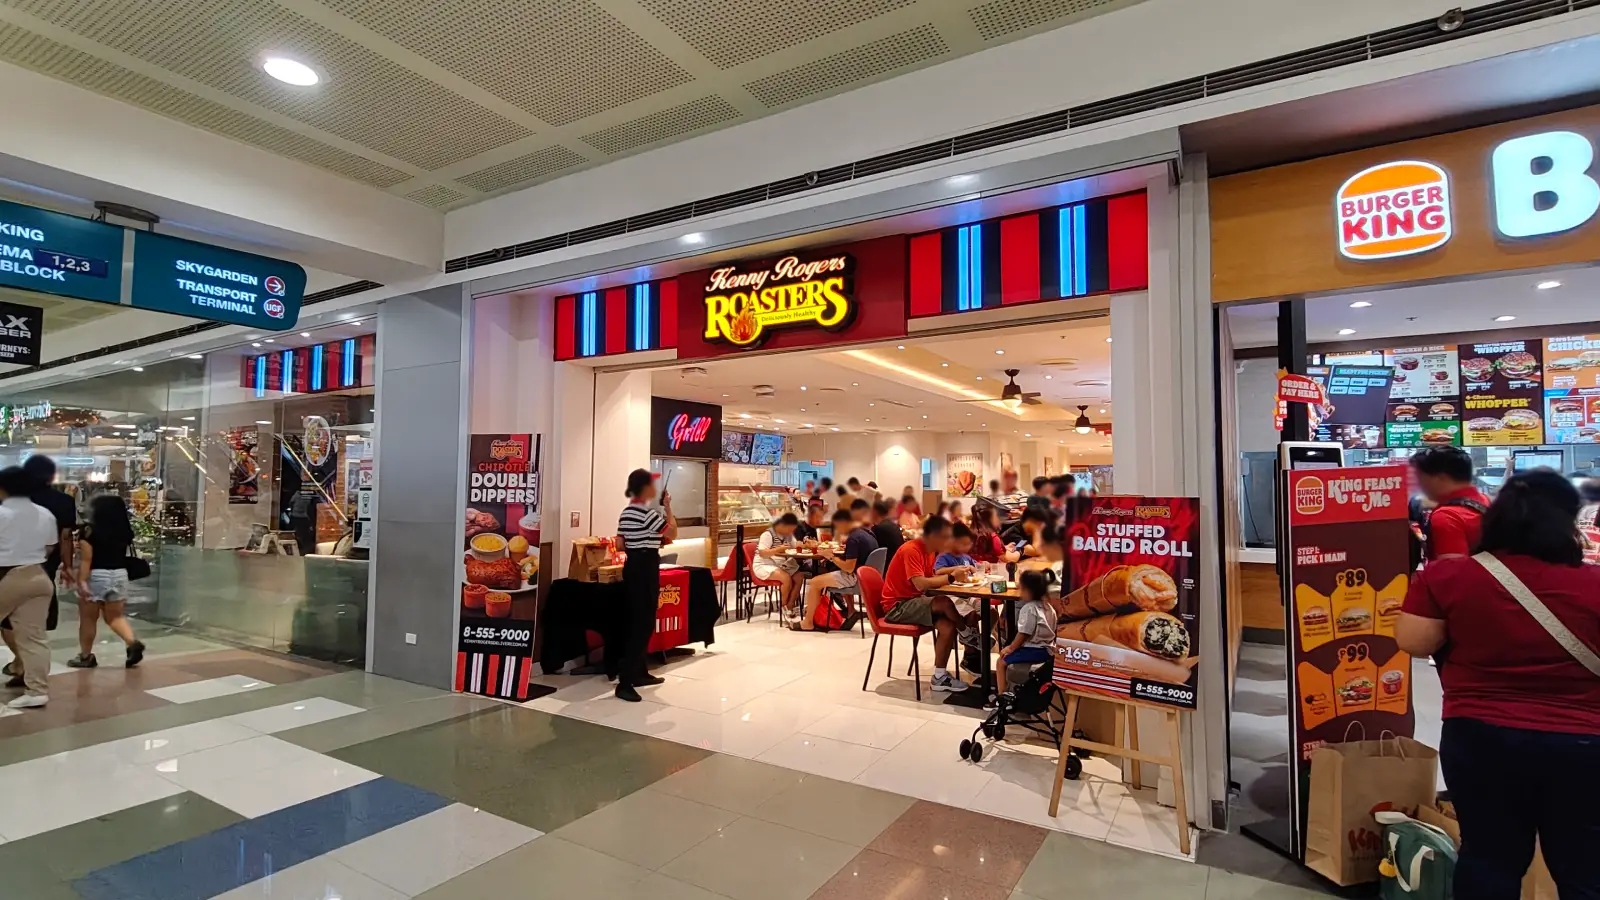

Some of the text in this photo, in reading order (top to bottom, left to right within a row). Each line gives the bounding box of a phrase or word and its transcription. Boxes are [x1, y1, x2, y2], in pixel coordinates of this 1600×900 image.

[1492, 131, 1600, 237] B
[1341, 185, 1445, 218] BURGER
[1342, 205, 1447, 243] KING
[0, 244, 91, 272] MA 1,2,3
[0, 260, 66, 281] BLOCK
[175, 259, 258, 286] SKYGARDEN
[705, 256, 846, 291] Kenny Rogers
[176, 278, 258, 303] TRANSPORT
[189, 294, 256, 315] TERMINAL
[266, 303, 282, 313] UGF
[704, 276, 848, 345] ROASTERS
[793, 309, 817, 319] Healthy
[0, 315, 30, 331] X
[0, 344, 31, 355] RNEYS:
[1281, 379, 1310, 390] ORDER
[1281, 387, 1320, 399] PAY HERE
[1464, 398, 1529, 409] WHOPPER
[670, 413, 712, 450] Grill
[478, 462, 531, 472] CHIPOTLE
[471, 472, 537, 488] DOUBLE
[1364, 477, 1402, 491] FEAST
[470, 488, 536, 503] DIPPERS
[1297, 488, 1322, 497] BURGER
[1297, 496, 1323, 507] KING
[1351, 491, 1391, 512] for Me
[1096, 523, 1165, 538] STUFFED
[1072, 535, 1193, 558] BAKED ROLL
[1297, 547, 1314, 555] STEP
[1297, 554, 1318, 565] PICK
[1324, 552, 1347, 562] MAIN
[463, 626, 530, 641] 8-555-9000
[1135, 683, 1193, 700] 8-555-9000
